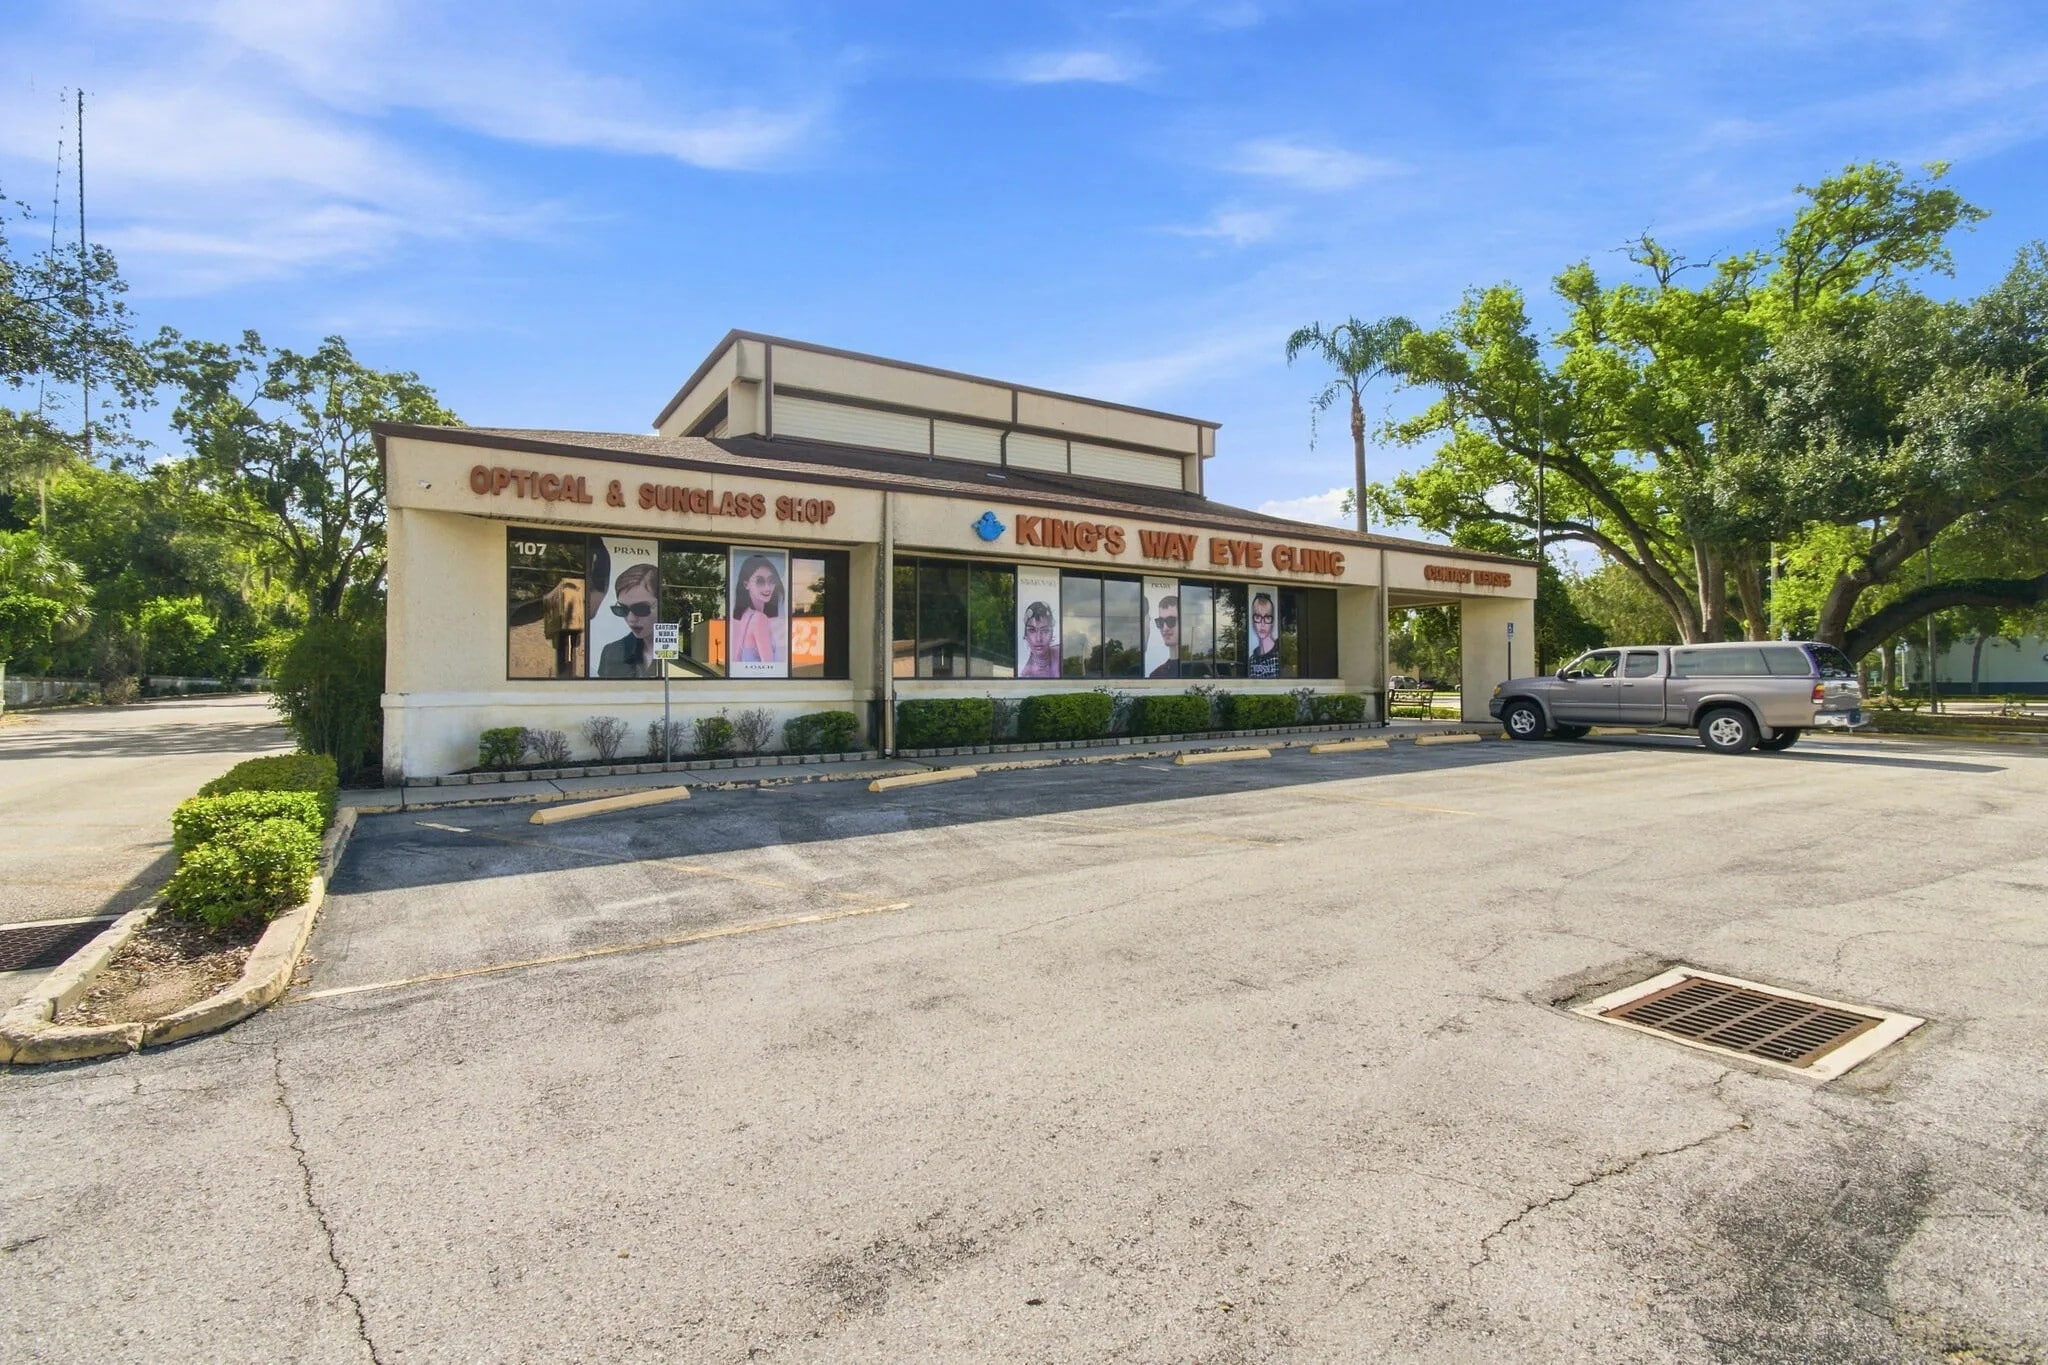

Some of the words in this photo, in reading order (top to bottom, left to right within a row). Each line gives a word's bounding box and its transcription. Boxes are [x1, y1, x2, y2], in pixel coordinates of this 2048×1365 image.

[470, 464, 593, 504] OPTICAL
[606, 479, 625, 507] &
[638, 482, 766, 519] SUNGLASS
[775, 495, 835, 524] SHOP
[515, 541, 547, 556] 107
[613, 546, 650, 556] PRADA
[1016, 514, 1126, 555] KING'S
[1138, 529, 1198, 562] WAY
[1210, 537, 1263, 568] EYE
[1271, 544, 1345, 576] CLINIC
